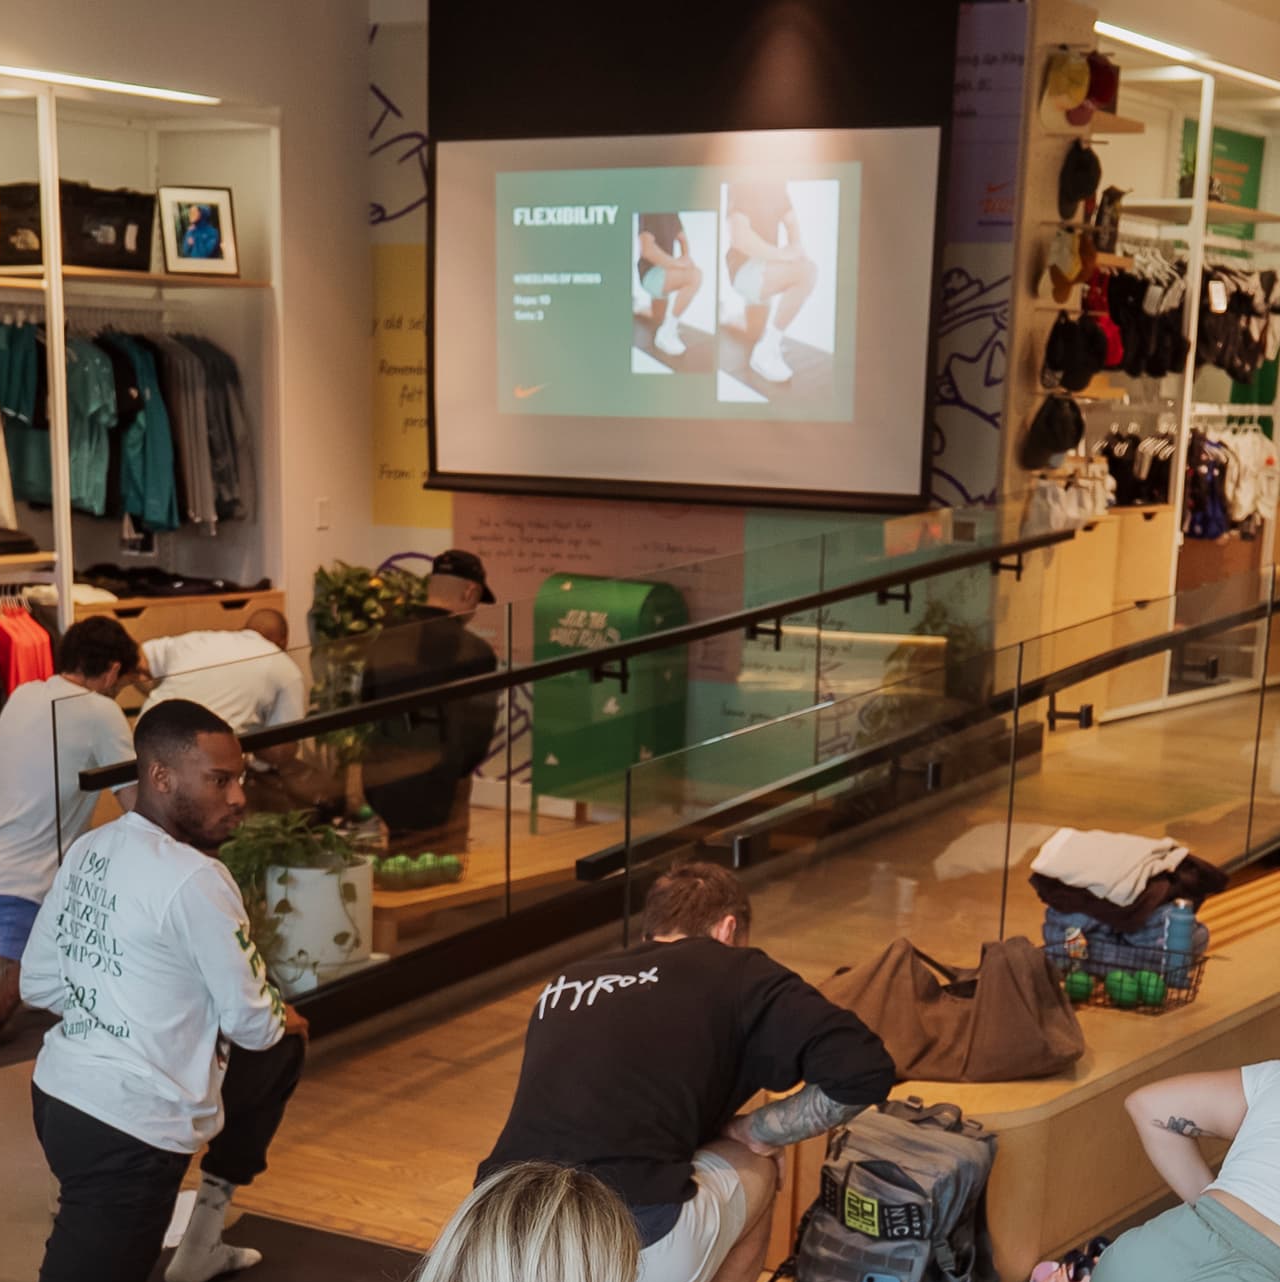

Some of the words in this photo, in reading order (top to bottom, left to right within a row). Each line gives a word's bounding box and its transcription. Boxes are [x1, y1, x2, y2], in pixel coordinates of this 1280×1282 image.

[513, 204, 619, 226] FLEXIBILITY
[538, 966, 659, 1020] HYROX
[889, 1207, 910, 1236] NYC
